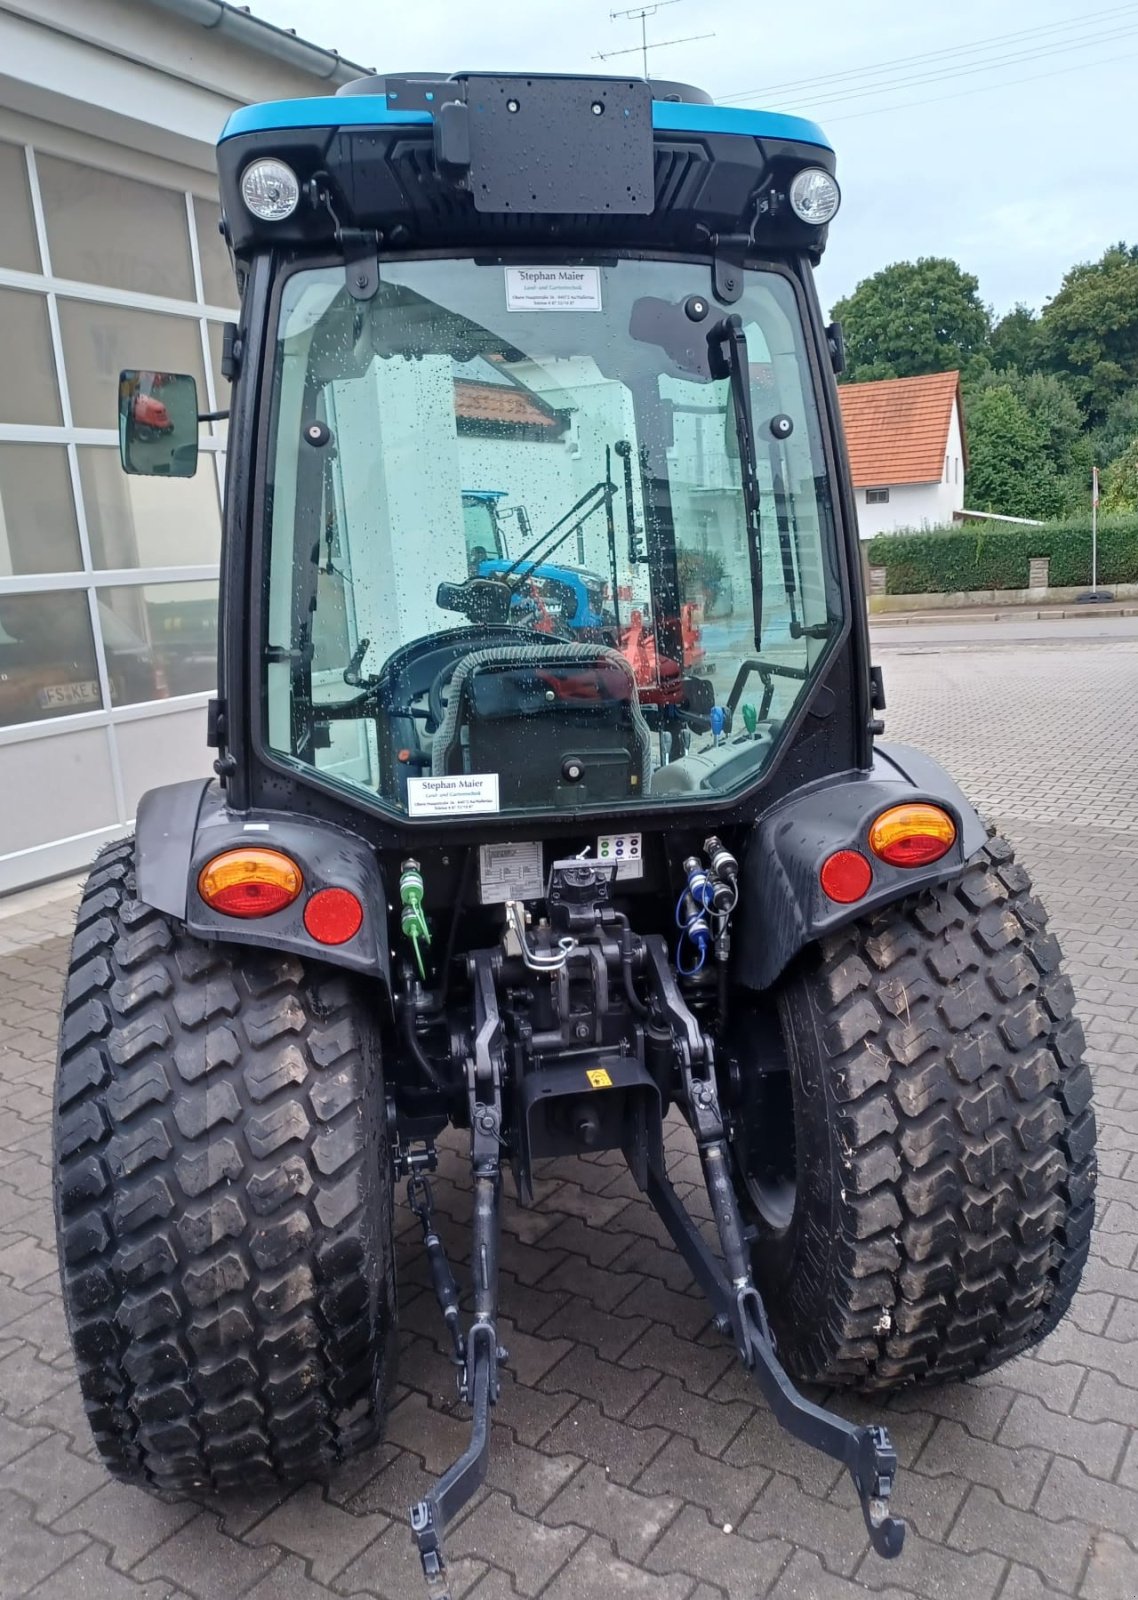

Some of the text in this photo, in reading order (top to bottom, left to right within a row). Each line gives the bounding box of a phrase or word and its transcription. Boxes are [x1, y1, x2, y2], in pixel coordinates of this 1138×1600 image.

[520, 271, 584, 283] Stephan Maier
[47, 687, 65, 703] FS
[72, 683, 89, 698] KE
[422, 779, 483, 791] Stephan Maier
